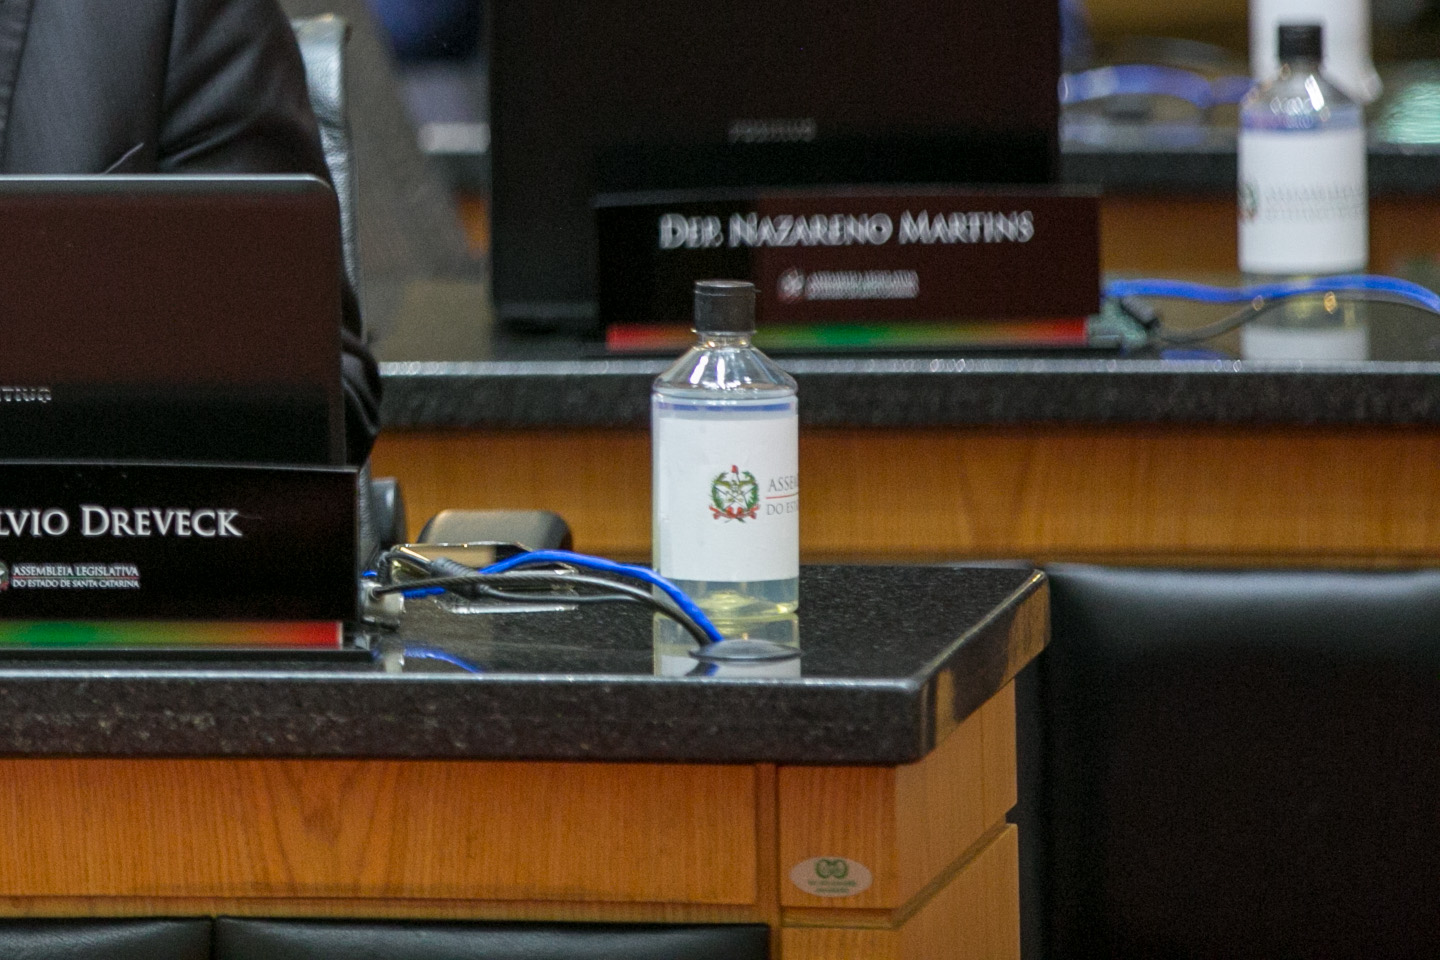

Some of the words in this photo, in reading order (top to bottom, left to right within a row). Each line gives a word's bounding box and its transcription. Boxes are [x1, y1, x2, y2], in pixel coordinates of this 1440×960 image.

[899, 209, 1034, 244] MARTINS
[79, 504, 242, 537] DREVECK
[12, 564, 74, 577] ASSEMBLEIA
[76, 564, 140, 577] LEGISLATIVA
[27, 578, 59, 588] ESTADO
[72, 578, 98, 588] SANTA
[99, 578, 140, 588] CATARINA
